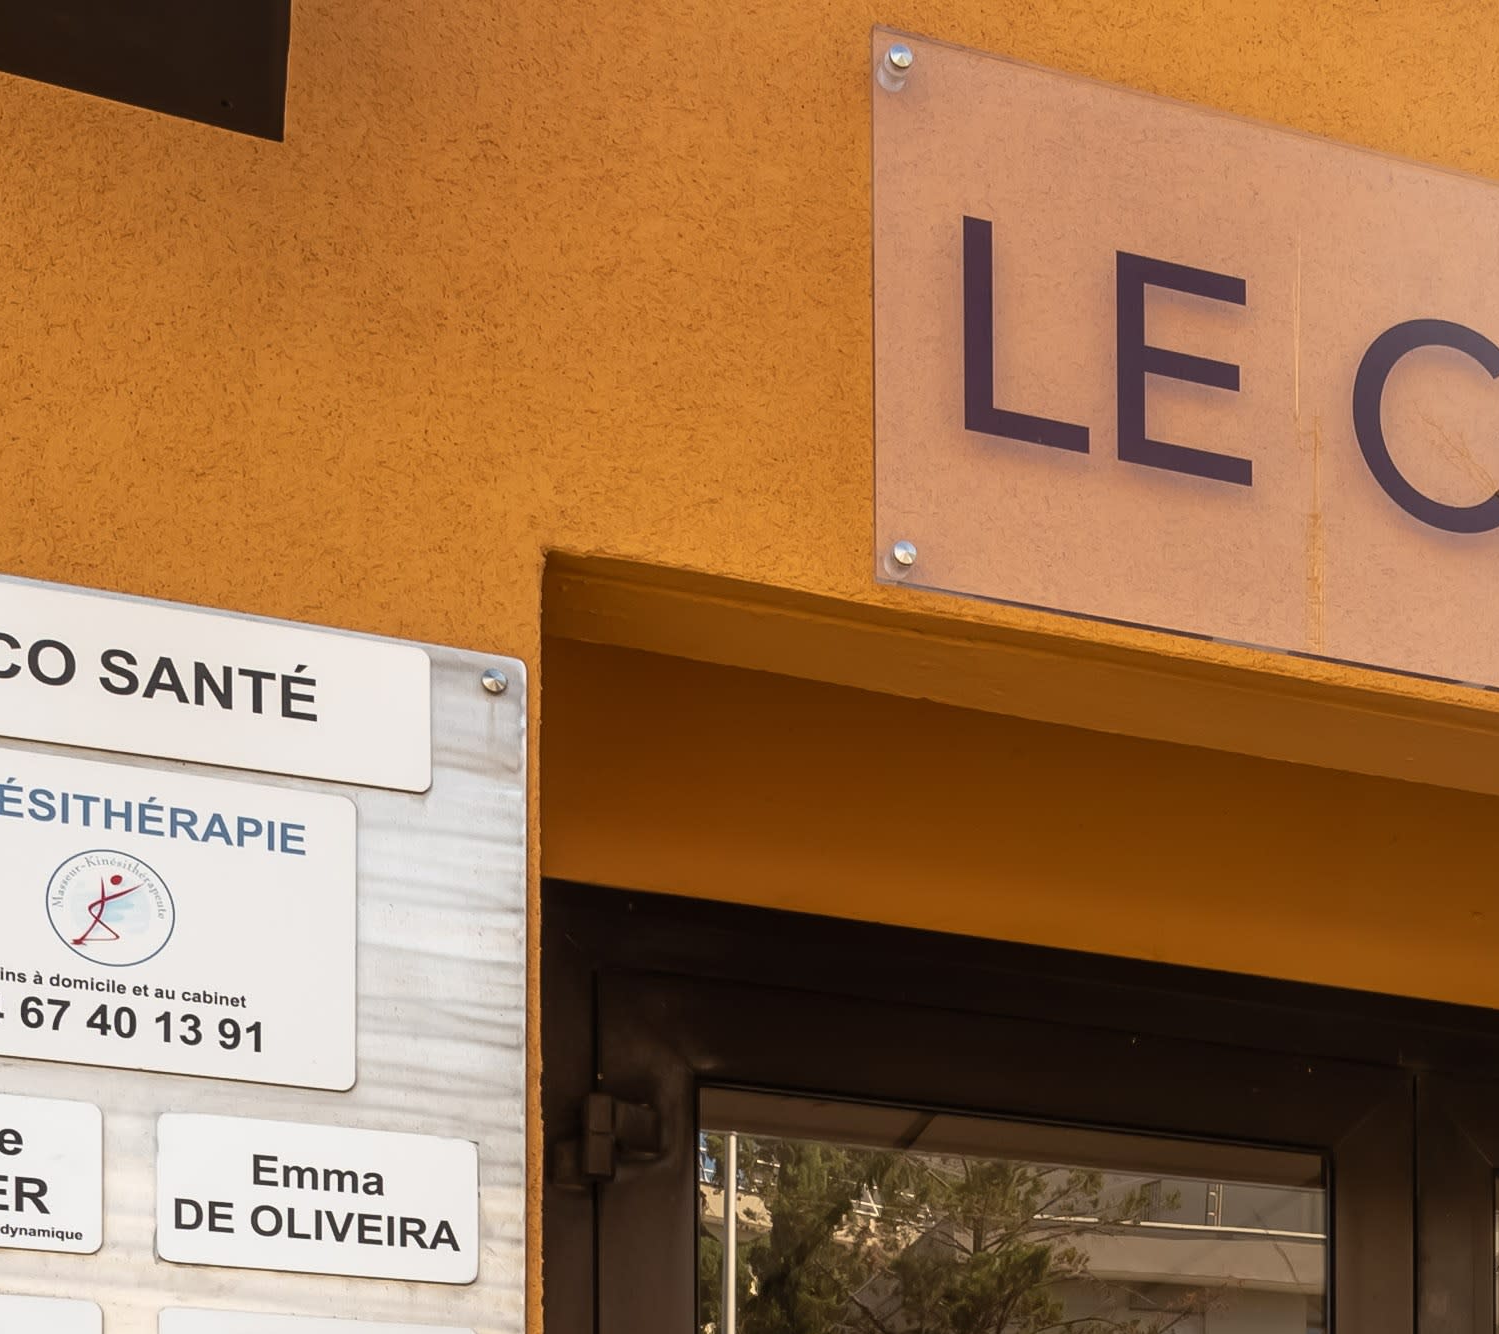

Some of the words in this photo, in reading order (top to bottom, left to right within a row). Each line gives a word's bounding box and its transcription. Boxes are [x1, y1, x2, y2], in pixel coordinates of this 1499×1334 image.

[961, 215, 1253, 488] LE
[99, 649, 317, 721] SANTÉ
[52, 855, 167, 920] Masseur-Kinésithérapeute
[33, 971, 42, 984] à
[50, 974, 126, 994] domicile
[133, 985, 149, 997] et
[155, 989, 175, 1000] au
[182, 990, 246, 1008] cabinet
[21, 997, 70, 1030] 67
[87, 1004, 136, 1038] 40
[156, 1011, 202, 1045] 13
[218, 1018, 261, 1052] 91
[253, 1154, 384, 1196] Emma
[175, 1198, 234, 1233] DE
[251, 1205, 460, 1251] OLIVEIRA
